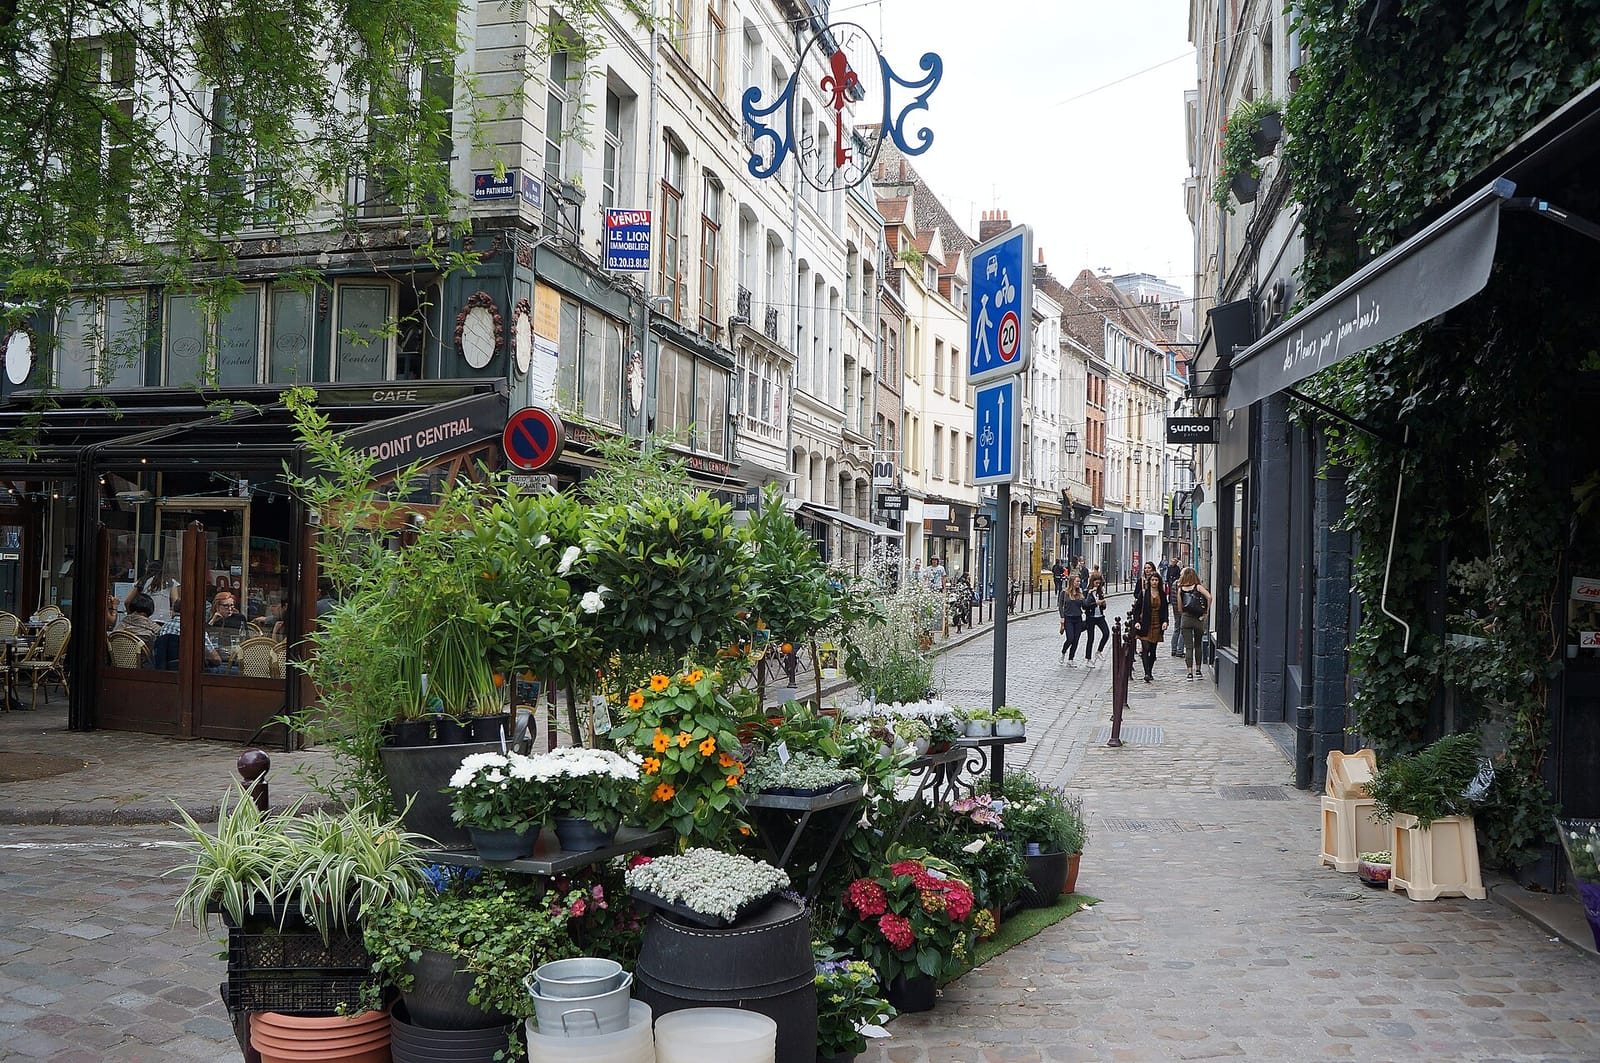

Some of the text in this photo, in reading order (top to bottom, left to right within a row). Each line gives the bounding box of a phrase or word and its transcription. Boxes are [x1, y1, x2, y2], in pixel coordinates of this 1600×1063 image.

[486, 186, 513, 195] PATINIERS
[610, 211, 648, 226] VENDU
[610, 230, 650, 242] LE LION
[610, 241, 649, 250] IMMOBILIER
[1003, 325, 1015, 346] 20
[1317, 330, 1333, 368] par
[372, 390, 418, 401] CAFE
[1170, 424, 1210, 433] suncoo
[369, 435, 413, 460] POINT
[416, 417, 473, 448] CENTRAL
